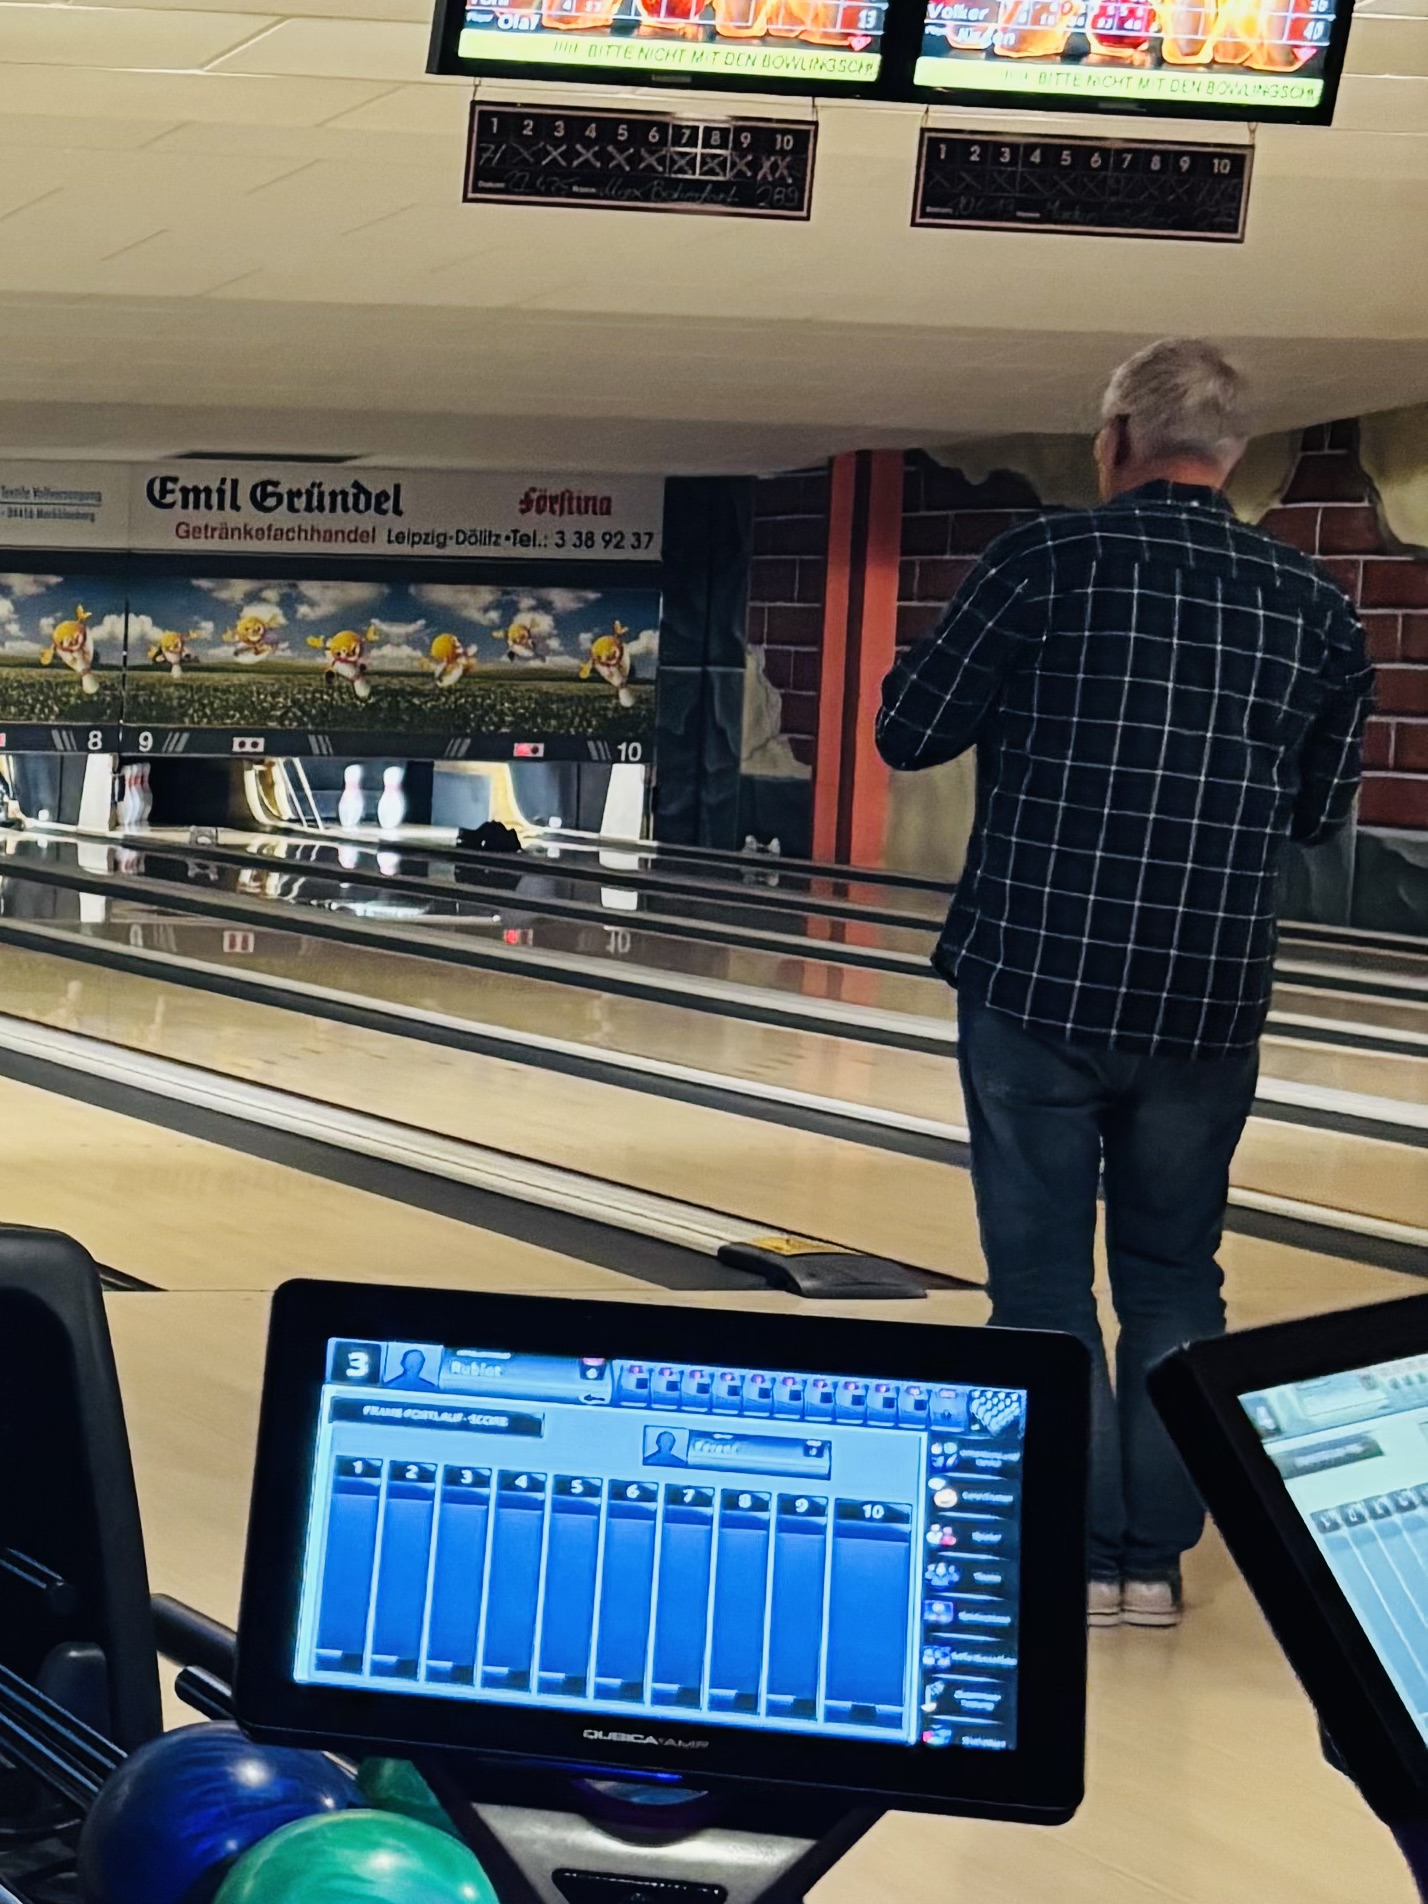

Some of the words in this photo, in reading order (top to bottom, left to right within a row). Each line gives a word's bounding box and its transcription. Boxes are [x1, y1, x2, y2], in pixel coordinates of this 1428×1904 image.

[498, 13, 541, 31] Olaf
[928, 4, 989, 21] Volker
[588, 44, 633, 60] BITTE
[638, 47, 686, 63] NICHT
[491, 118, 498, 134] 1
[522, 120, 534, 136] 2
[554, 121, 565, 137] 3
[585, 123, 597, 139] 4
[617, 125, 628, 141] 5
[648, 127, 660, 143] 6
[680, 129, 692, 144] 7
[710, 131, 721, 147] 8
[740, 132, 751, 149] 9
[775, 134, 794, 151] 10
[146, 475, 242, 513] Emil
[249, 478, 404, 518] Gründel
[175, 521, 376, 548] Getränkefachhandel
[555, 531, 565, 549] 3
[573, 531, 595, 549] 38
[602, 532, 625, 550] 92
[632, 533, 654, 551] 37
[87, 730, 104, 751] 8
[138, 731, 154, 752] 9
[617, 742, 643, 763] 10
[346, 1351, 369, 1377] 3
[353, 1459, 363, 1474] 1
[405, 1465, 419, 1479] 2
[460, 1469, 473, 1484] 3
[514, 1474, 527, 1489] 4
[570, 1479, 584, 1494] 5
[626, 1484, 640, 1499] 6
[682, 1488, 695, 1503] 7
[738, 1493, 751, 1508] 8
[795, 1497, 809, 1513] 9
[862, 1504, 885, 1520] 10
